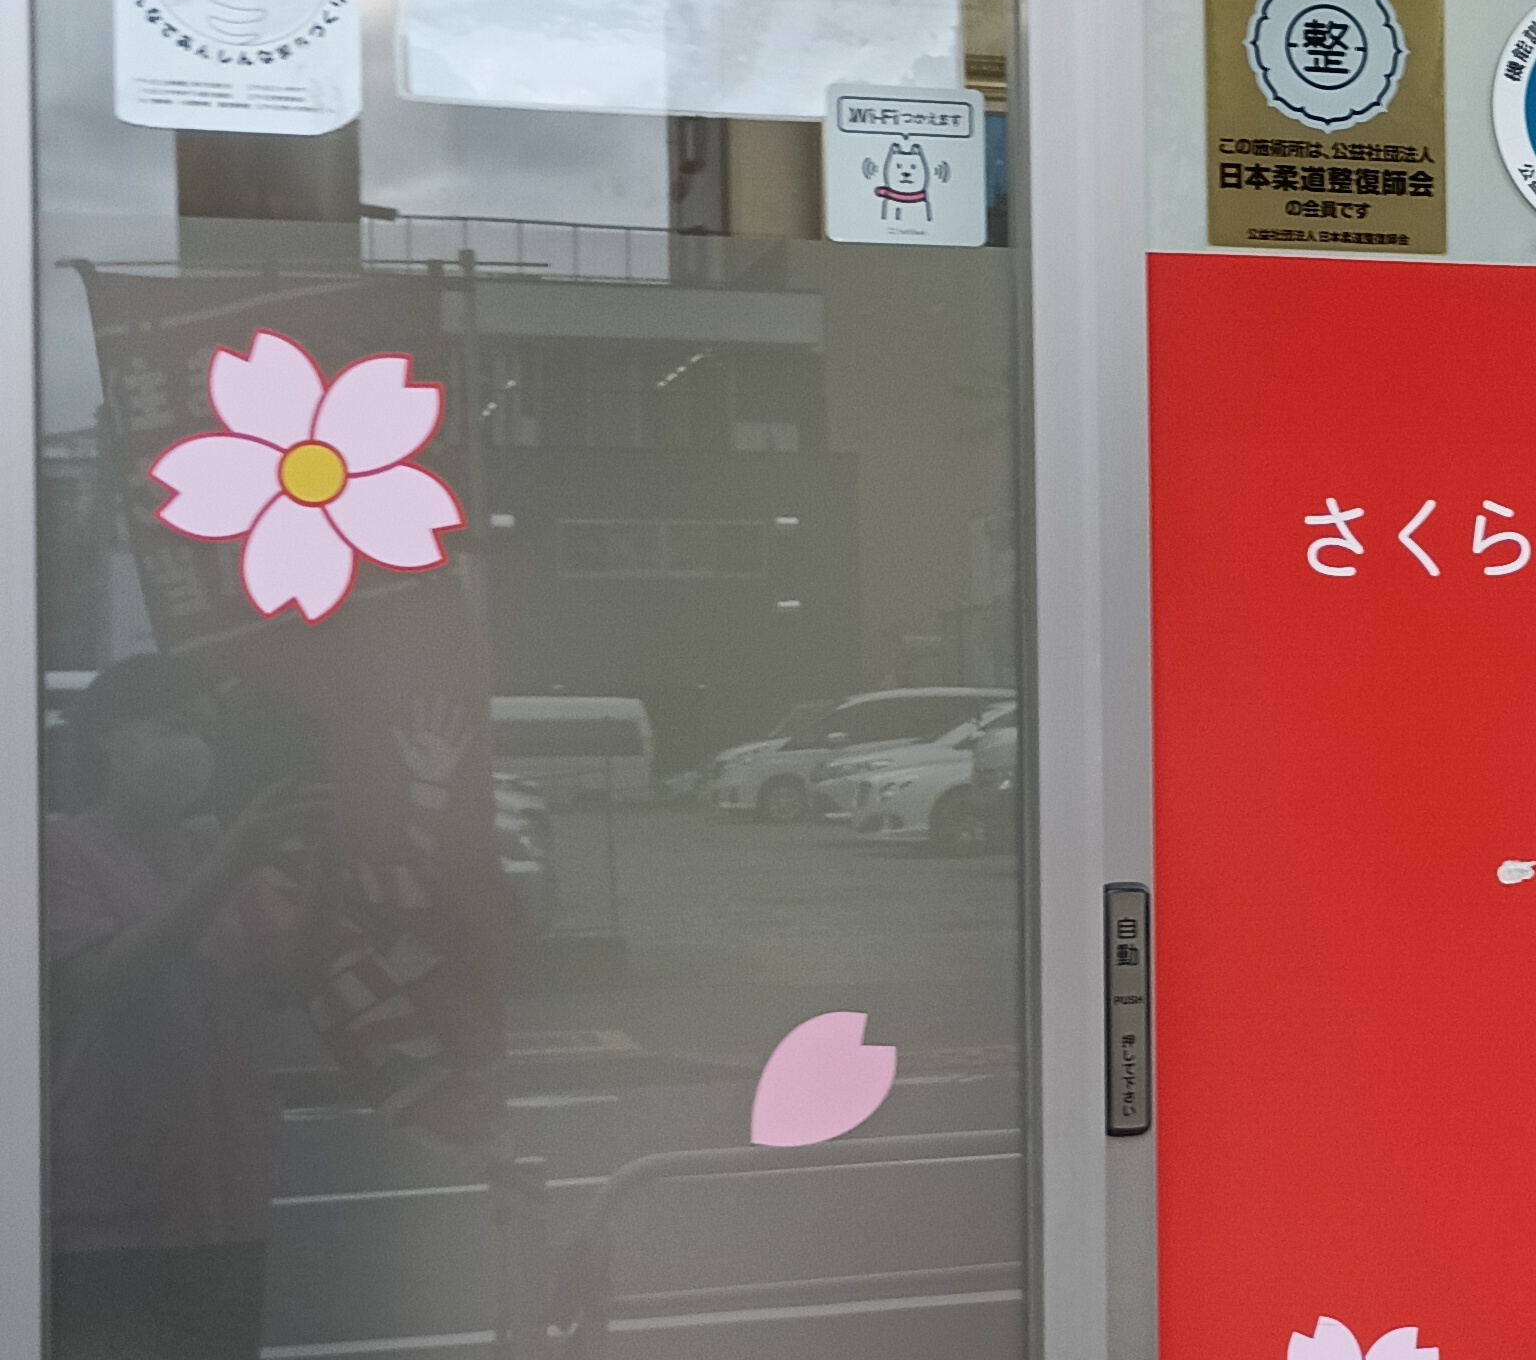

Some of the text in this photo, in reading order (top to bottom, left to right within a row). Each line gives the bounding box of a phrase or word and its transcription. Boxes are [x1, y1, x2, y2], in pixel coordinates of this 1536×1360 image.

[1303, 20, 1350, 75] 整
[1218, 163, 1436, 198] 日本柔道整復師会
[1286, 200, 1372, 220] の会員です
[1116, 917, 1140, 966] 自動
